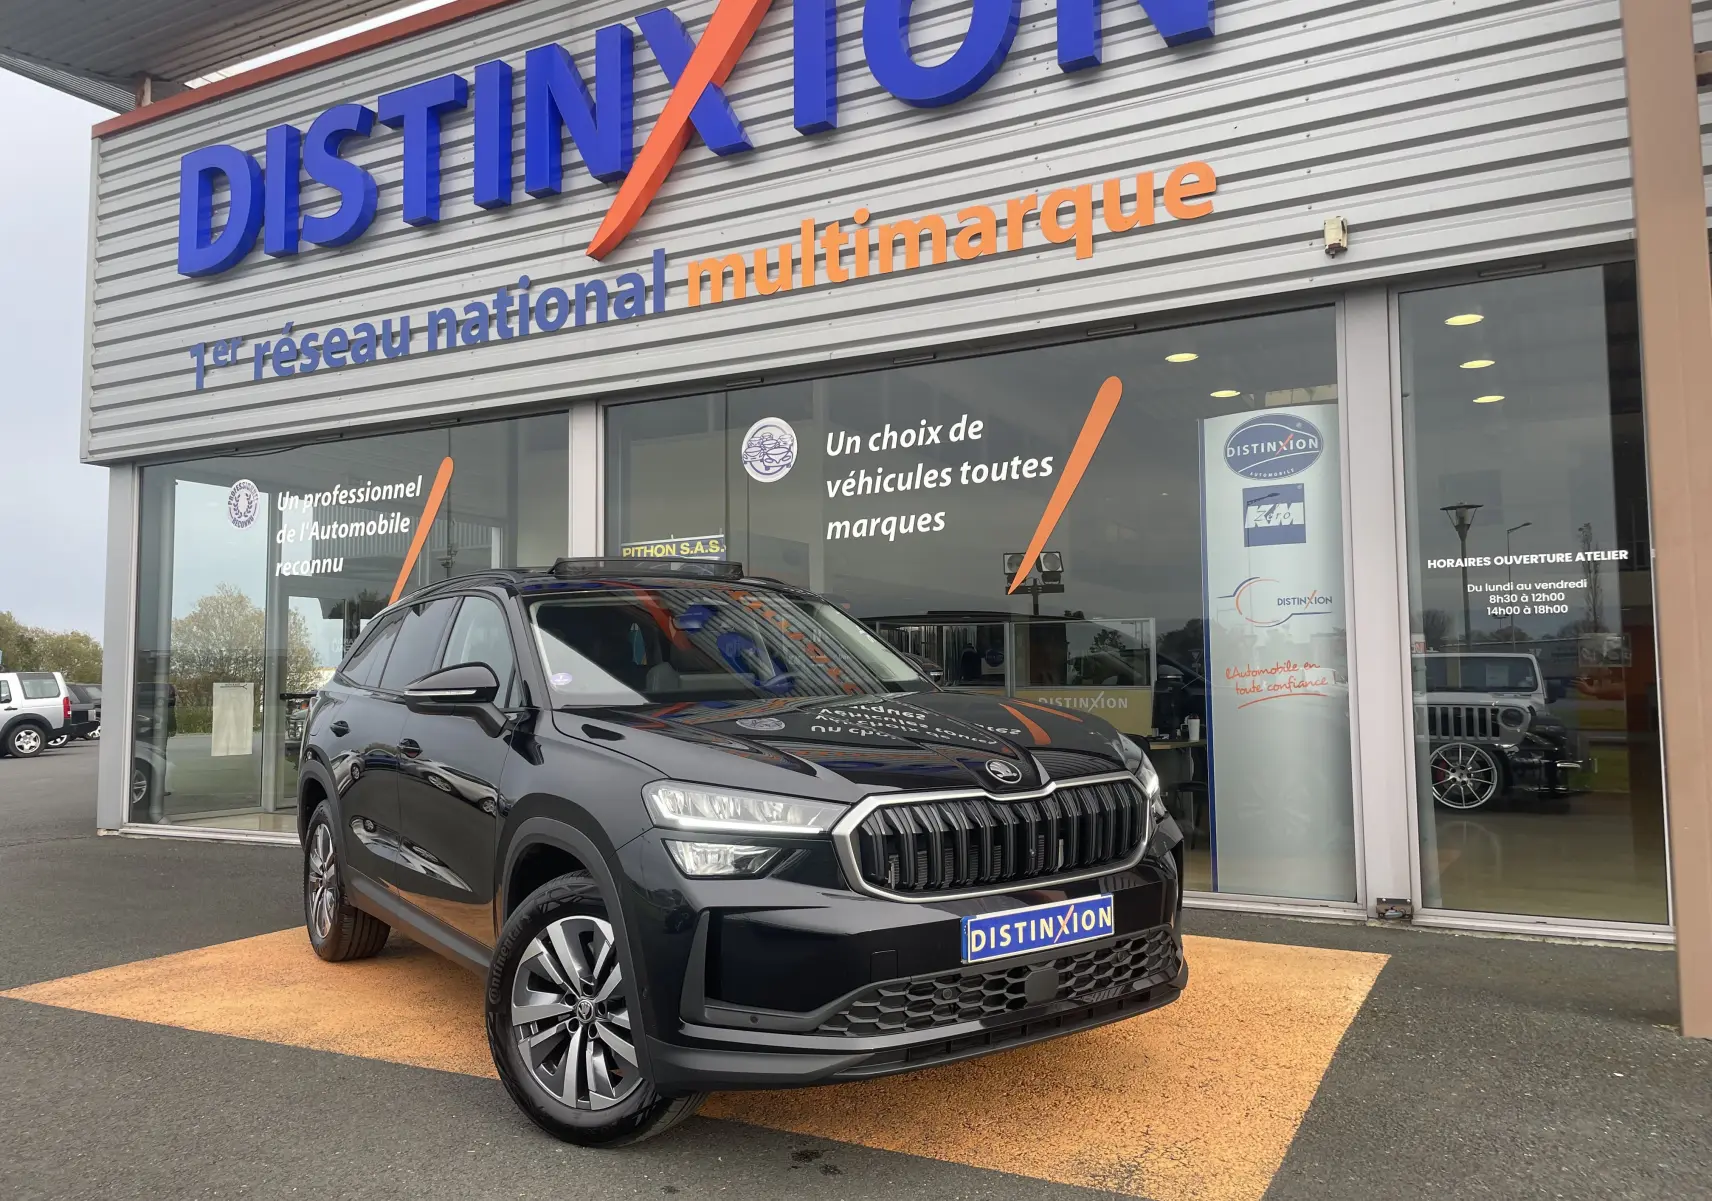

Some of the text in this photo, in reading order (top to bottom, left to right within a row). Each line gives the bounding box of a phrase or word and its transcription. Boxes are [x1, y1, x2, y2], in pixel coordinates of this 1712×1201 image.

[178, 0, 1216, 278] DISTINXIO
[189, 160, 1217, 390] 1er réseau national multimarque
[825, 413, 984, 457] Un choix de
[1226, 433, 1319, 458] DISTINXION
[825, 453, 1054, 499] véhicules toutes
[1249, 467, 1296, 478] AUTOMOBILE
[277, 474, 423, 514] Un professionnel
[825, 510, 947, 543] marques
[1244, 501, 1305, 529] KM
[276, 511, 411, 544] de l'Automobile
[622, 539, 725, 558] PITHON S.A.S.
[1427, 549, 1629, 569] HORAIRES OUVERTURE ATELIER
[275, 556, 344, 577] reconnu
[1467, 578, 1587, 593] Du lundi au vendredi
[1277, 590, 1333, 610] DISTINXION
[1489, 592, 1565, 604] 8h30 à 12h00
[1486, 604, 1568, 616] 14h00 à 18h00
[1303, 661, 1320, 669] en
[1236, 676, 1328, 695] toute confiance
[971, 904, 1112, 953] DISTINXION
